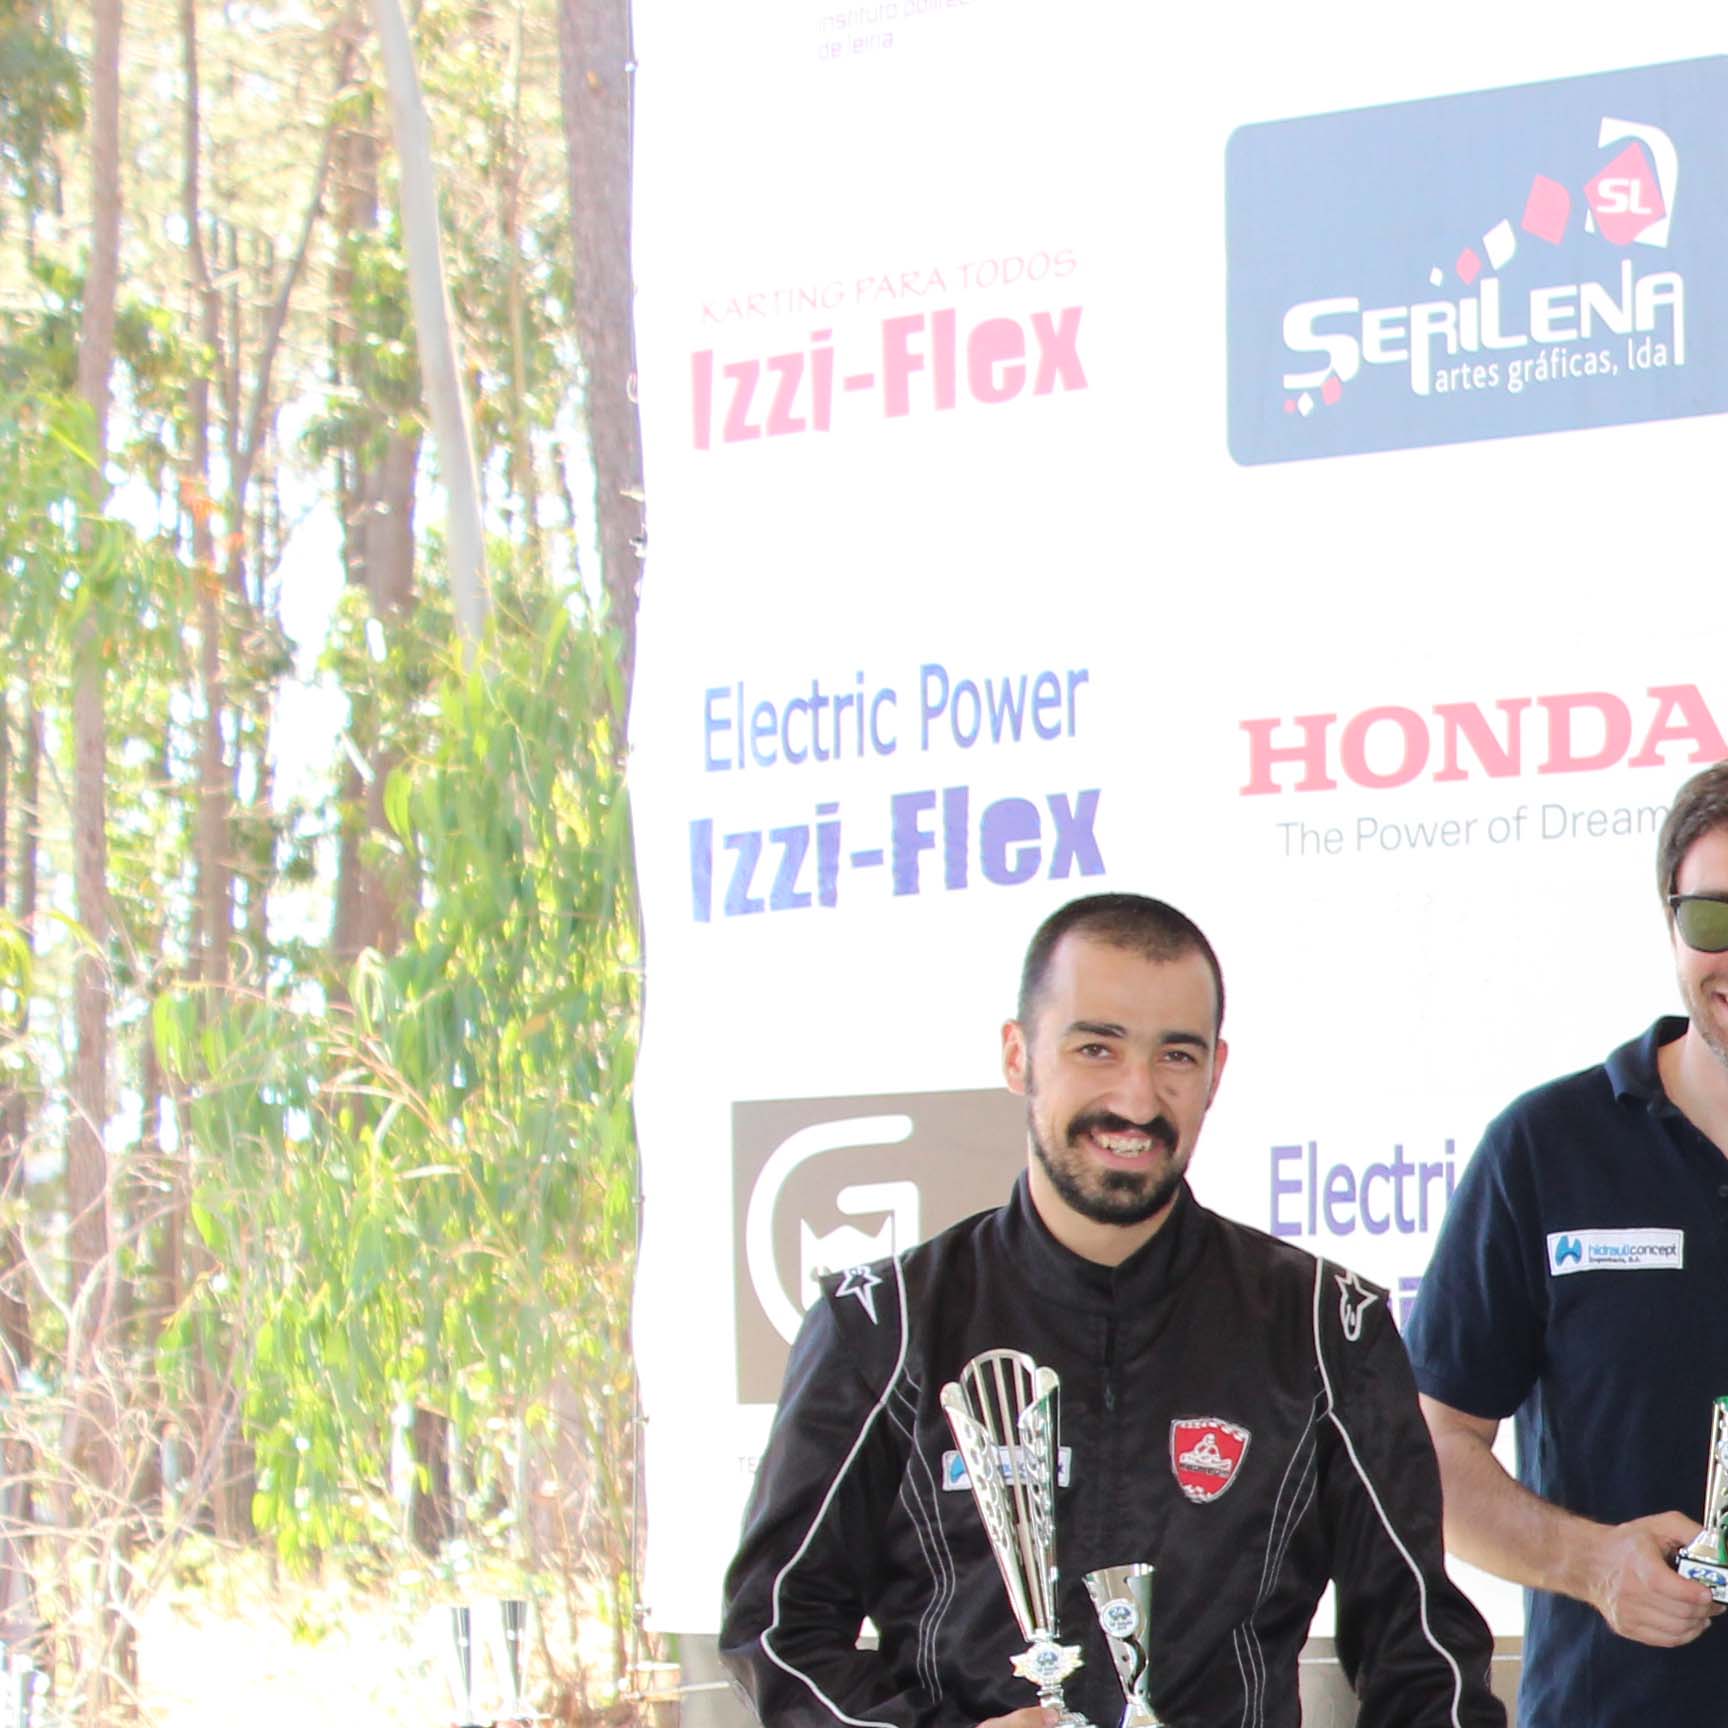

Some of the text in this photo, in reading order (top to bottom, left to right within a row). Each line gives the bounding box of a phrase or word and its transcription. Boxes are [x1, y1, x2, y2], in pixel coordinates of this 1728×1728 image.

[1596, 178, 1651, 214] SL
[701, 248, 1078, 324] KARTING PARA TODOS
[691, 306, 1088, 450] Izzi-Flex
[1434, 338, 1668, 393] artes gráficas, lda
[703, 664, 1089, 772] Electric Power
[689, 785, 1106, 923] Izzi-Flex
[1276, 803, 1668, 857] The Power of Dream
[1269, 1138, 1456, 1237] Electri
